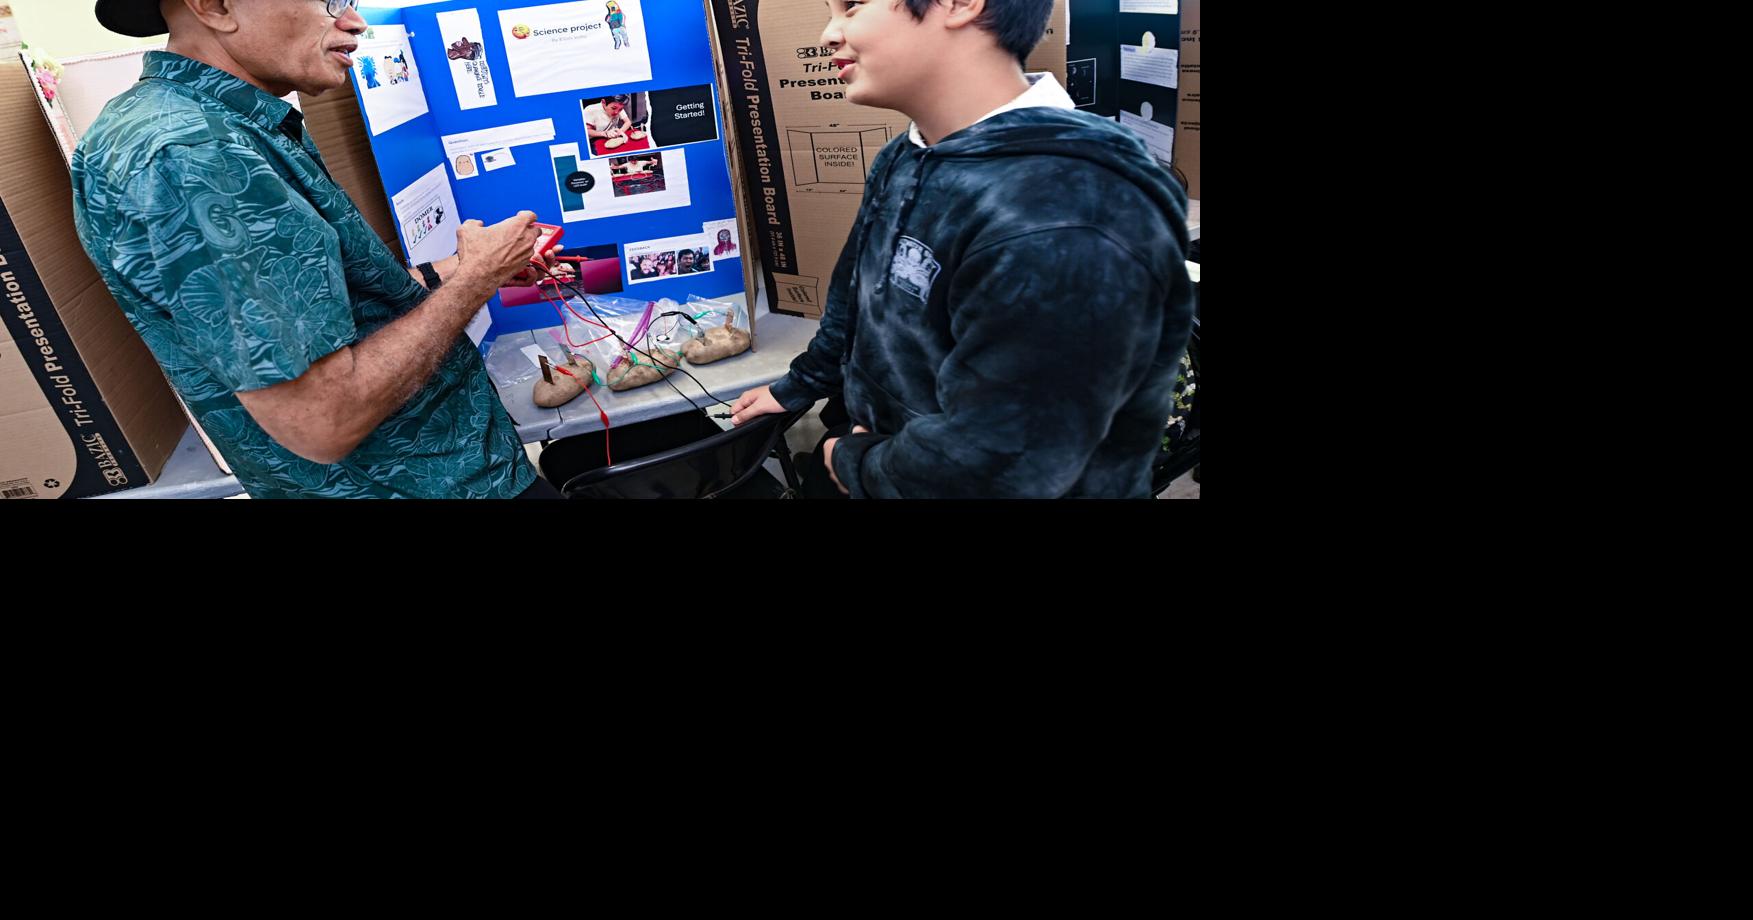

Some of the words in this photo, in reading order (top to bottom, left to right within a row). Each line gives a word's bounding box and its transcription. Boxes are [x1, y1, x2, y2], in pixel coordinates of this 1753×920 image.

[533, 26, 568, 37] Science
[570, 22, 602, 34] project
[735, 37, 759, 91] Tri-Fold
[779, 77, 845, 88] Present
[674, 110, 705, 119] Started!
[676, 102, 705, 111] Getting
[746, 95, 771, 183] Presentation
[763, 187, 780, 225] Board
[0, 271, 63, 372] Presentation
[50, 375, 94, 427] Tri-Fold
[81, 433, 112, 469] BAZIC
